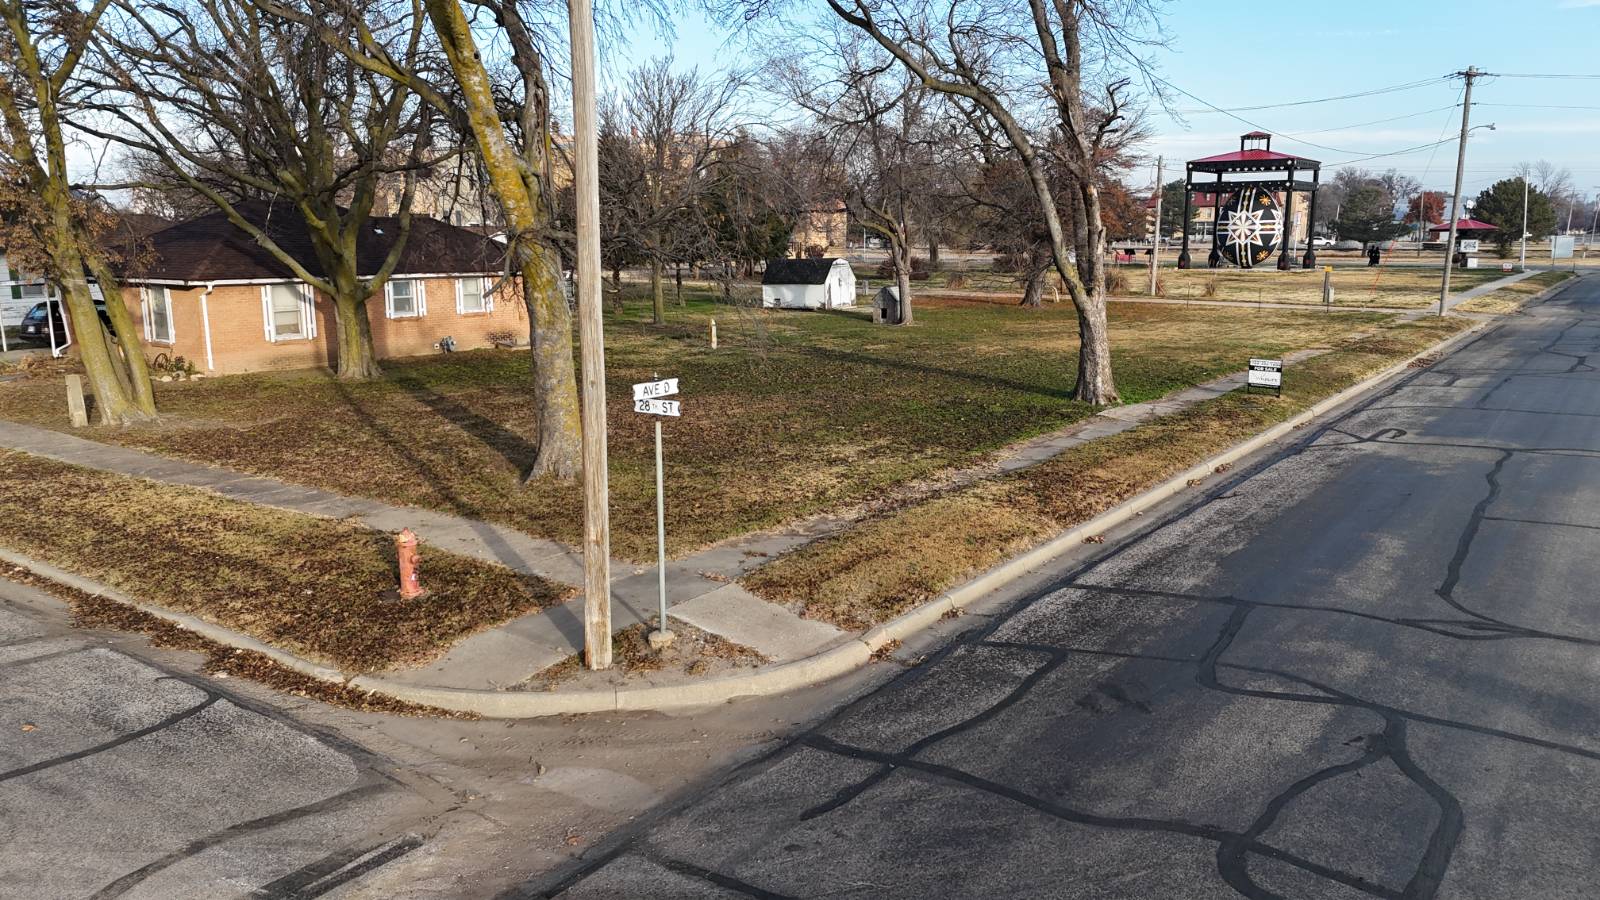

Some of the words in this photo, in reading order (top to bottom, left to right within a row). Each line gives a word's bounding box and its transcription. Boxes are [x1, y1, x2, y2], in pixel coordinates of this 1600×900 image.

[643, 383, 660, 396] AVE
[664, 381, 670, 393] D
[662, 401, 673, 414] ST
